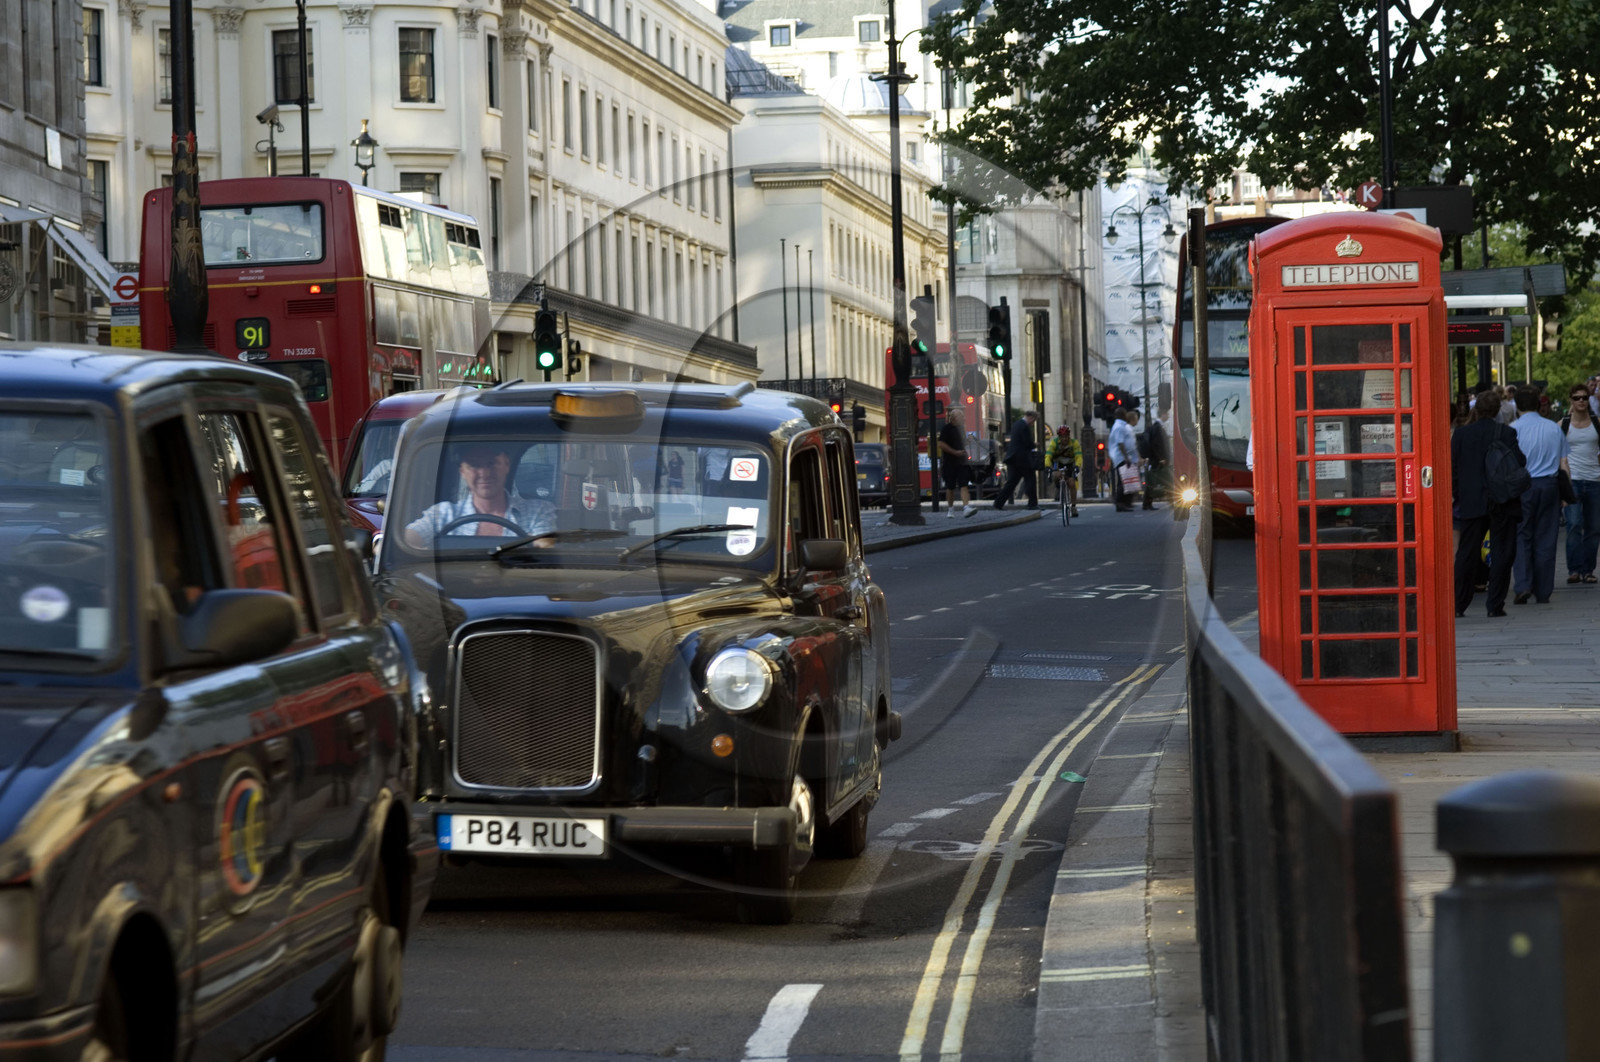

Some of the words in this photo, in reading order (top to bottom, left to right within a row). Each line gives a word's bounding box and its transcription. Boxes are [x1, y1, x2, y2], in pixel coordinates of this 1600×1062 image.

[1363, 185, 1377, 203] K
[1287, 263, 1413, 284] TELEPHONE
[243, 326, 264, 347] 91
[283, 348, 295, 356] TN
[296, 347, 316, 356] 32852
[1361, 432, 1394, 440] accepted
[467, 819, 521, 846] P84
[532, 822, 587, 848] RUC
